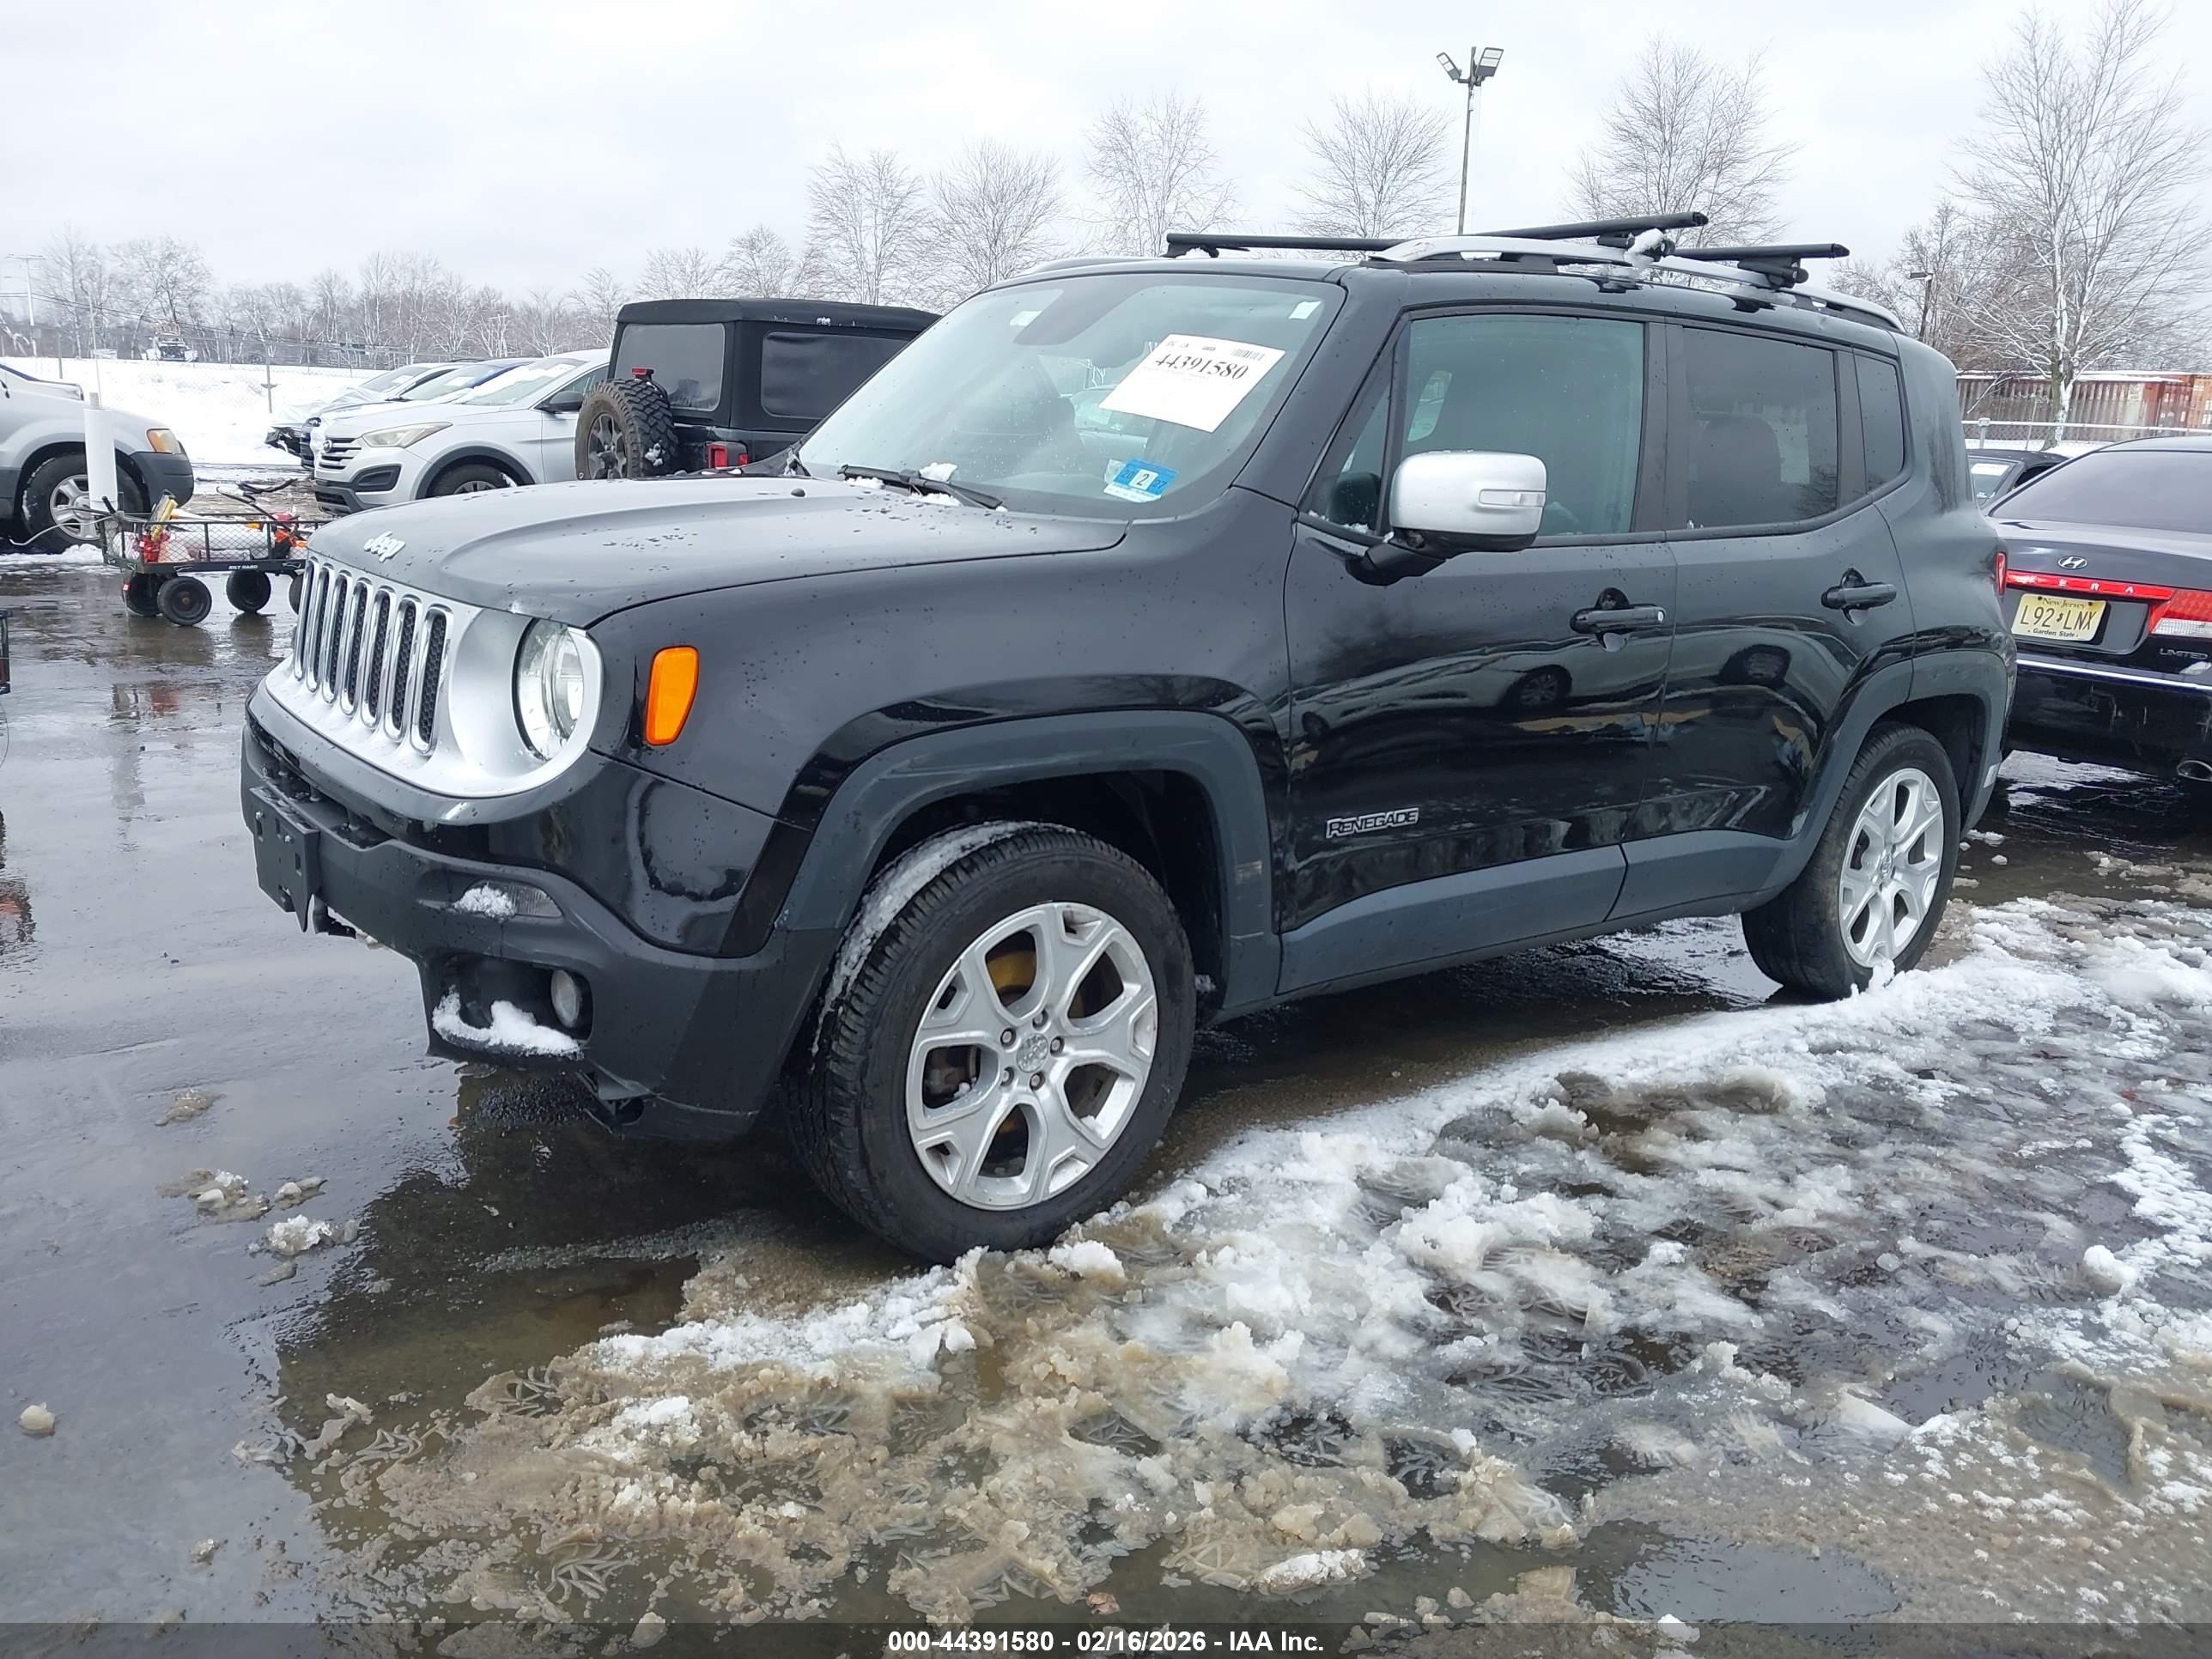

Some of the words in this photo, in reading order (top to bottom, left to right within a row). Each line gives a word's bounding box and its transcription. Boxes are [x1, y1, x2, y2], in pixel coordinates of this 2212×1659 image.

[1155, 353, 1249, 380] 44391580
[1136, 473, 1151, 486] 2
[363, 531, 406, 563] Jeep
[2043, 597, 2060, 606] New
[2060, 599, 2087, 610] Jersey
[2033, 628, 2057, 636] Garden
[2159, 648, 2209, 660] LIMITED
[1326, 807, 1419, 839] RENEGADE
